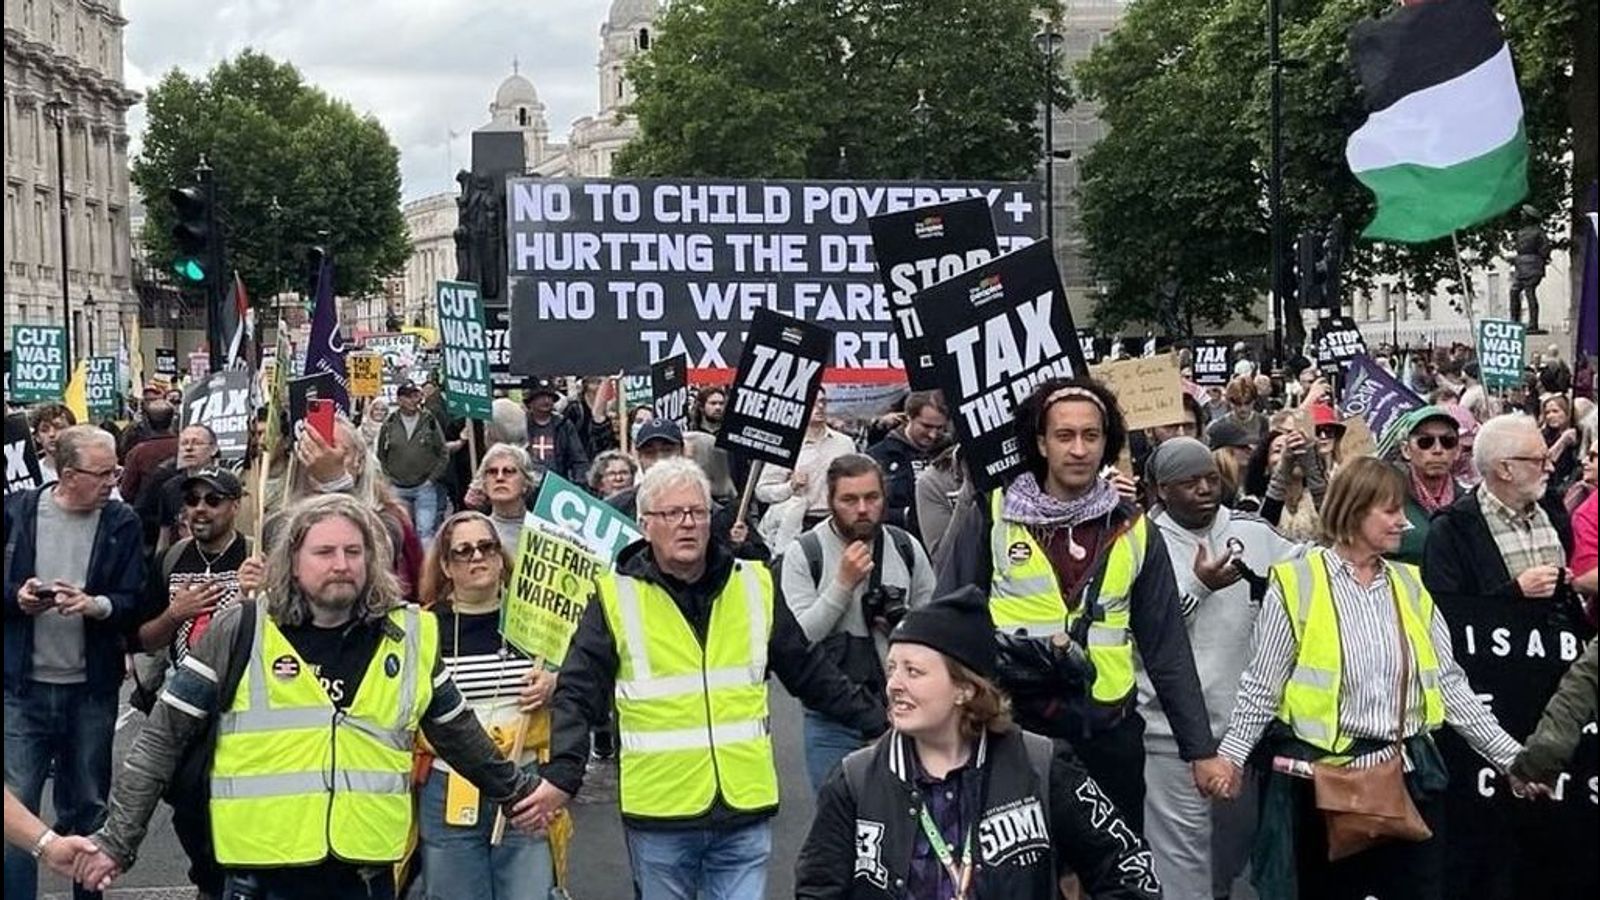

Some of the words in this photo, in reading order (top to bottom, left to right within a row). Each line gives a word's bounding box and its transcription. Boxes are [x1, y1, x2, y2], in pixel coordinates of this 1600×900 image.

[513, 183, 571, 222] NO
[584, 184, 641, 222] TO
[653, 185, 791, 223] CHILD
[516, 232, 714, 271] HURTING
[725, 234, 808, 272] THE
[440, 287, 477, 319] CUT
[538, 281, 595, 320] NO
[608, 282, 664, 320] TO
[17, 329, 60, 346] CUT
[441, 318, 484, 350] WAR
[946, 290, 1062, 399] TAX
[1326, 330, 1359, 346] STOP
[1483, 337, 1522, 354] WAR
[1484, 323, 1523, 339] CUT
[17, 347, 62, 364] WAR
[352, 357, 371, 365] TAX
[445, 347, 485, 379] NOT
[640, 331, 728, 369] TAX
[1196, 346, 1227, 362] TAX
[1483, 351, 1521, 368] NOT
[17, 364, 61, 382] NOT
[447, 379, 488, 397] WELFARE
[744, 344, 821, 402] TAX
[190, 388, 249, 425] TAX
[655, 386, 687, 420] STOP
[734, 387, 768, 421] THE
[764, 394, 806, 430] RICH
[959, 386, 1015, 438] THE
[521, 554, 558, 586] NOT
[526, 531, 602, 581] WELFARE
[516, 576, 586, 623] WARFAR
